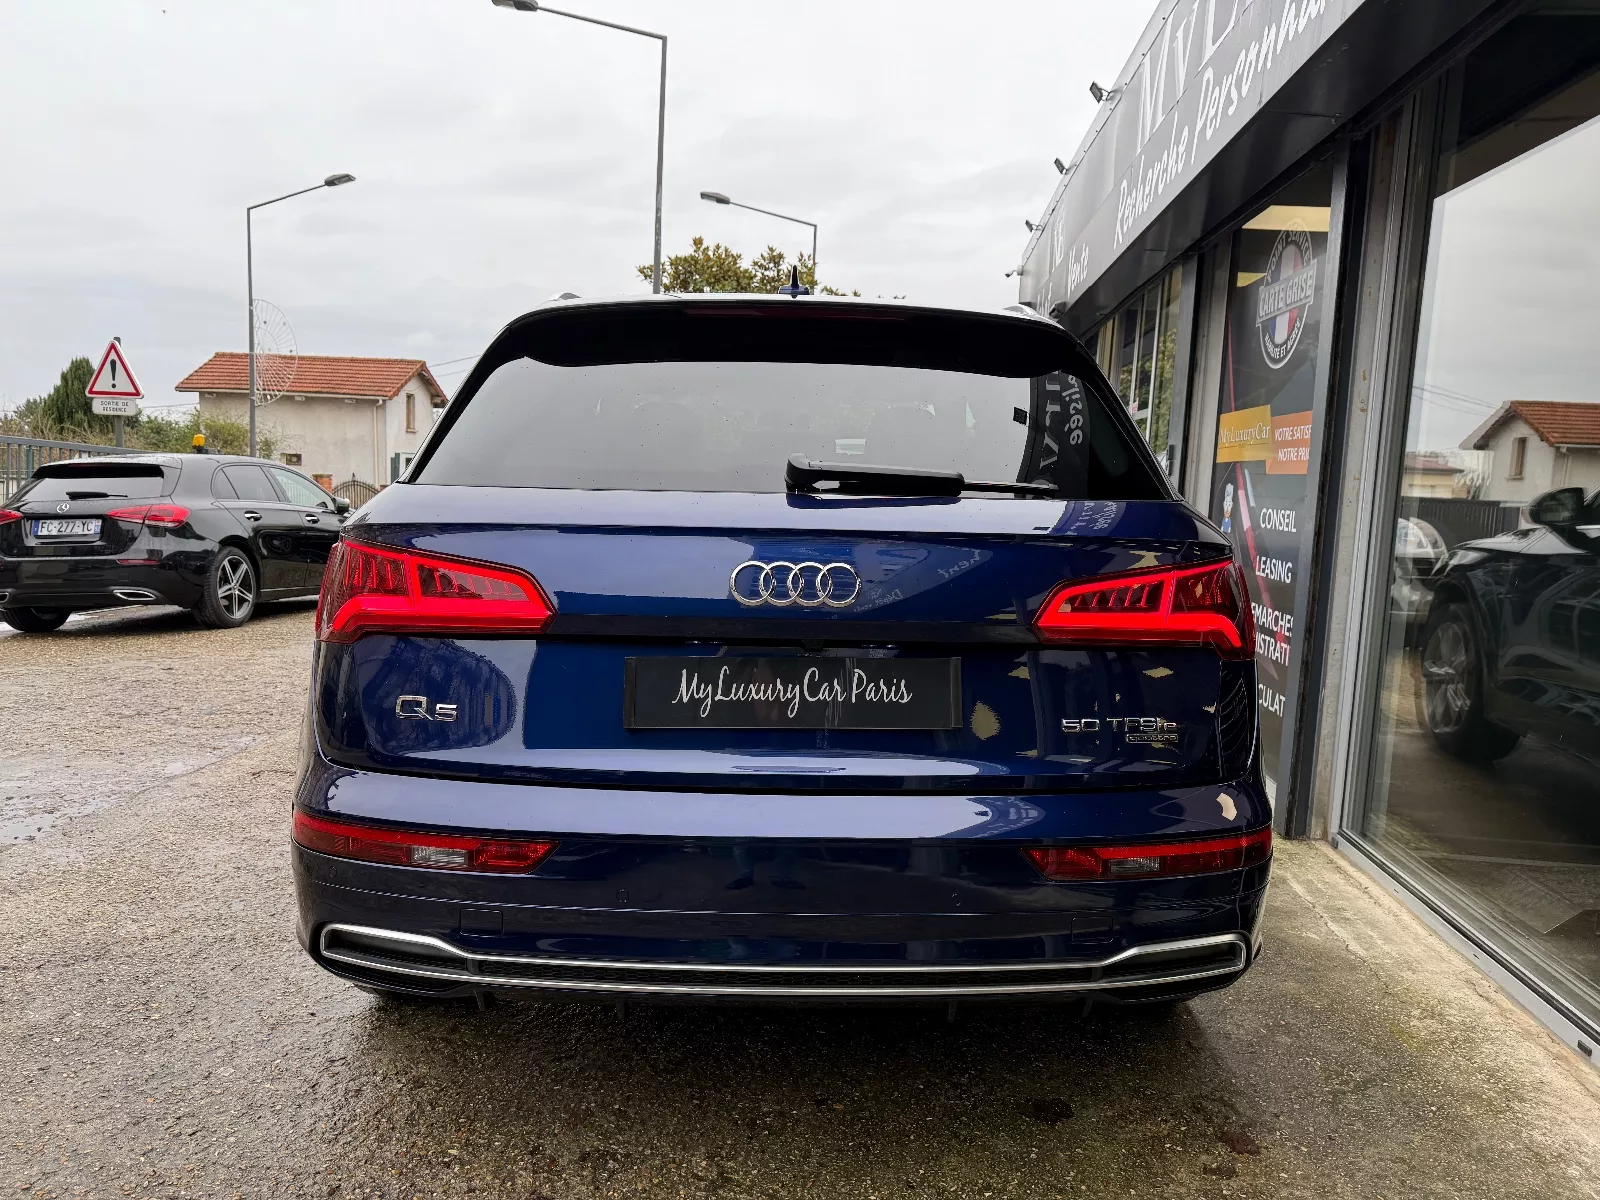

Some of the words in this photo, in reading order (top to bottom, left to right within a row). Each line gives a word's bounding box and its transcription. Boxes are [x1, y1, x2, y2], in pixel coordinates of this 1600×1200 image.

[1114, 111, 1189, 250] Recherche
[1259, 286, 1285, 317] CARTE
[1286, 269, 1314, 306] GRISE
[1280, 343, 1287, 358] ET
[1274, 426, 1293, 442] VOTRE
[1277, 447, 1298, 462] NOTRE
[40, 521, 93, 533] FC-277-YC
[1260, 507, 1297, 533] CONSEIL
[1255, 554, 1293, 584] LEASING
[851, 668, 913, 704] Paris
[1062, 718, 1100, 733] 50
